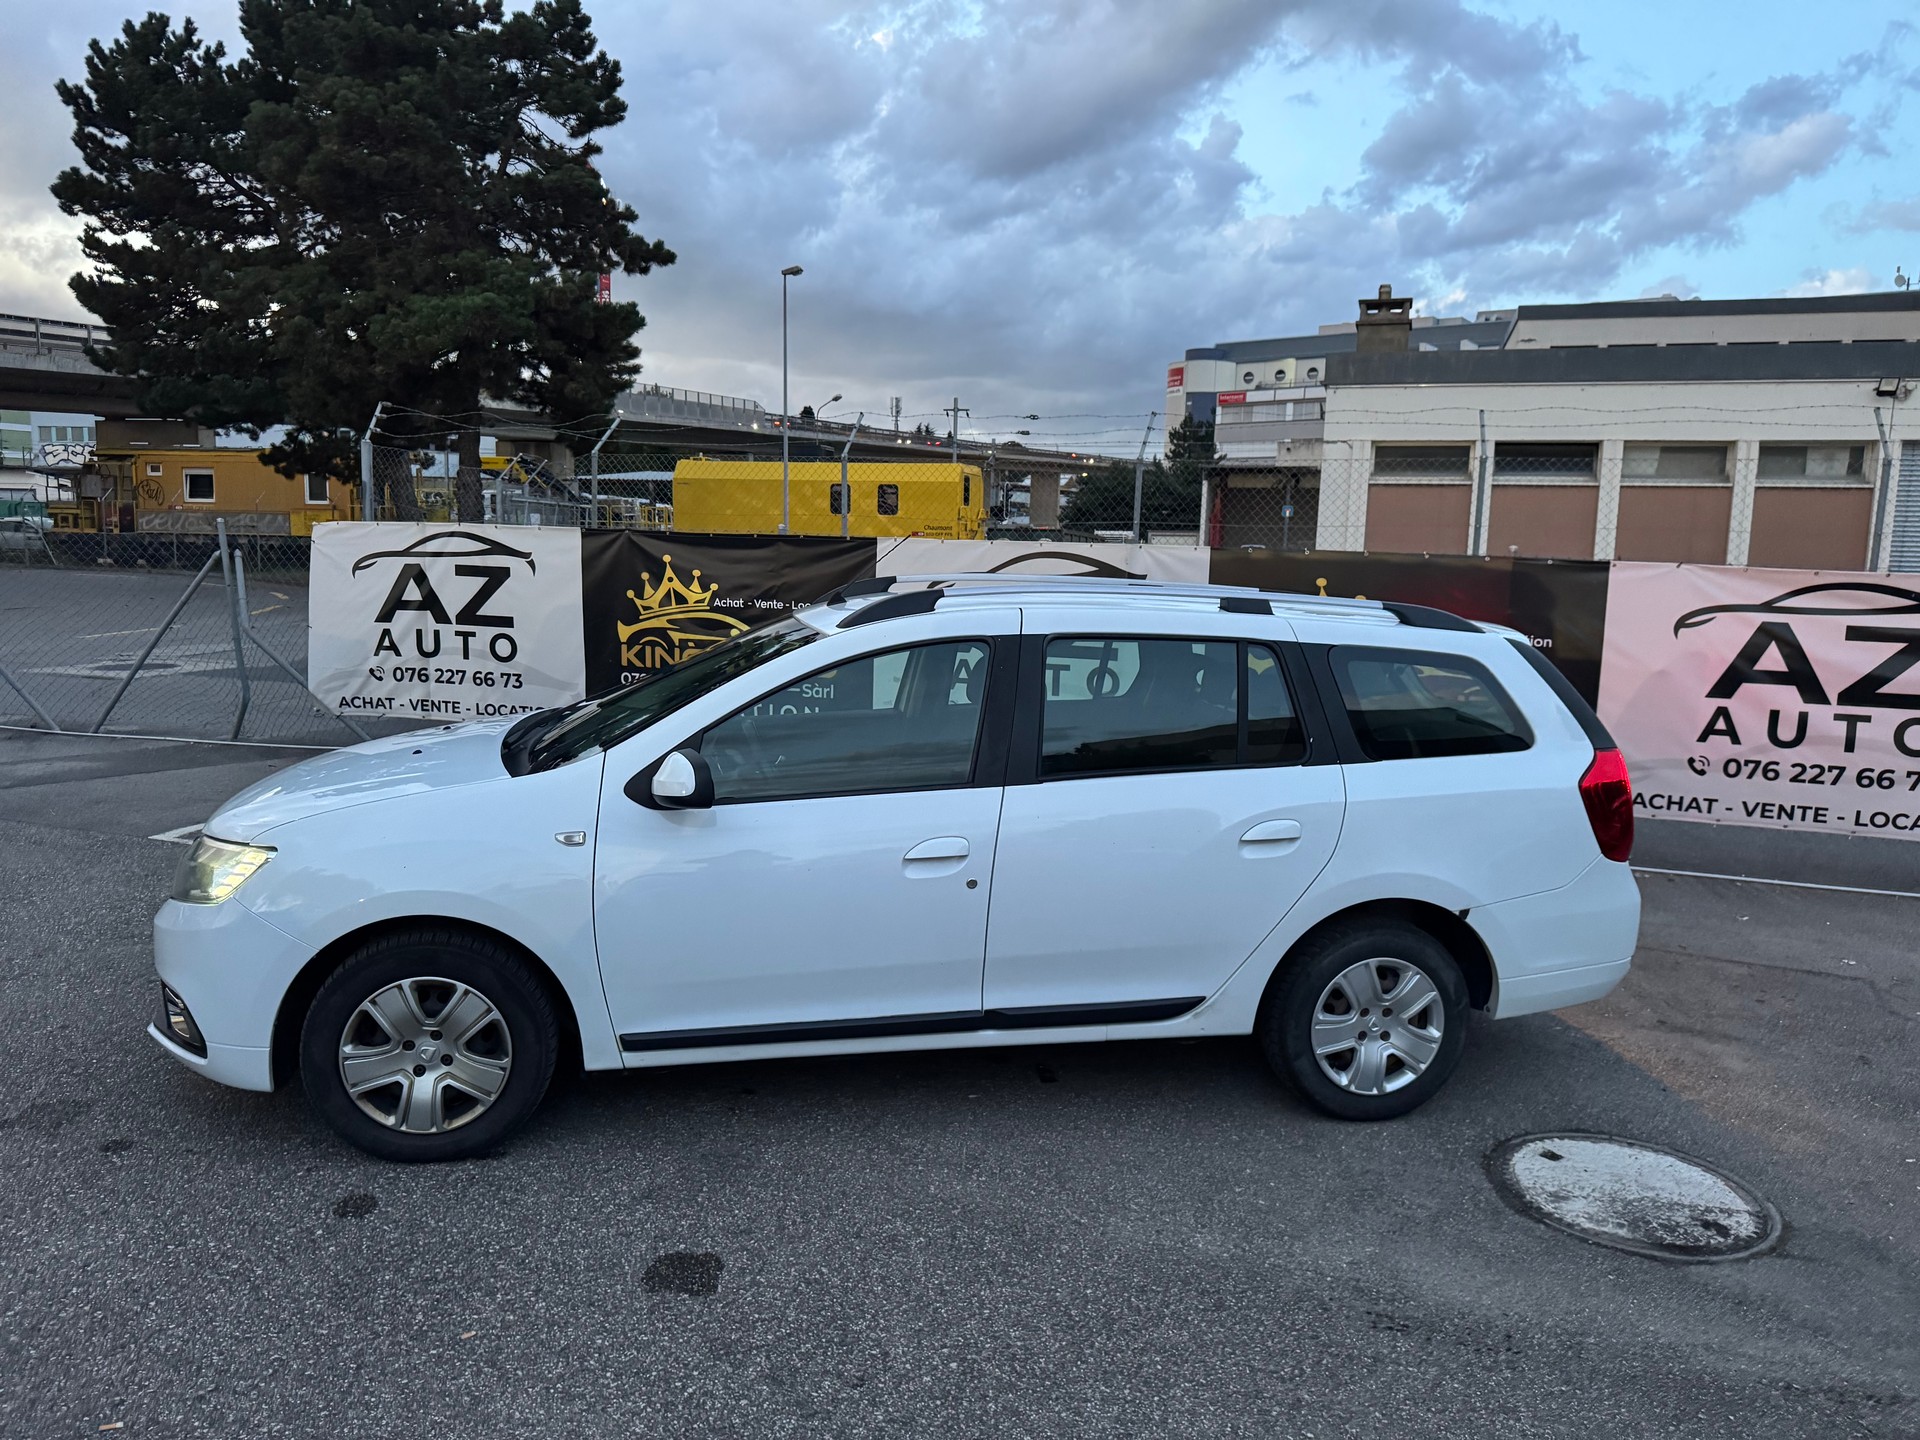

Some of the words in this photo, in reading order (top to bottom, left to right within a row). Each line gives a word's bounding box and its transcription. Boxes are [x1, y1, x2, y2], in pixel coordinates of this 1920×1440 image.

[374, 563, 515, 629] AZ
[713, 597, 744, 608] Achat
[754, 599, 784, 610] Vente
[373, 628, 518, 663] AUTO
[1526, 635, 1552, 648] ion
[392, 666, 430, 684] 076
[434, 668, 467, 686] 227
[472, 670, 495, 688] 66
[500, 672, 523, 690] 73
[1704, 621, 1920, 710] AZ
[338, 696, 395, 711] ACHAT
[409, 699, 462, 714] VENTE
[802, 682, 834, 699] Sàrl
[1695, 706, 1920, 758] AUTO
[1722, 758, 1780, 782] 076
[1788, 763, 1847, 787] 227
[1855, 767, 1896, 790] 66
[1633, 792, 1718, 815] ACHAT
[1742, 801, 1829, 824] VENTE
